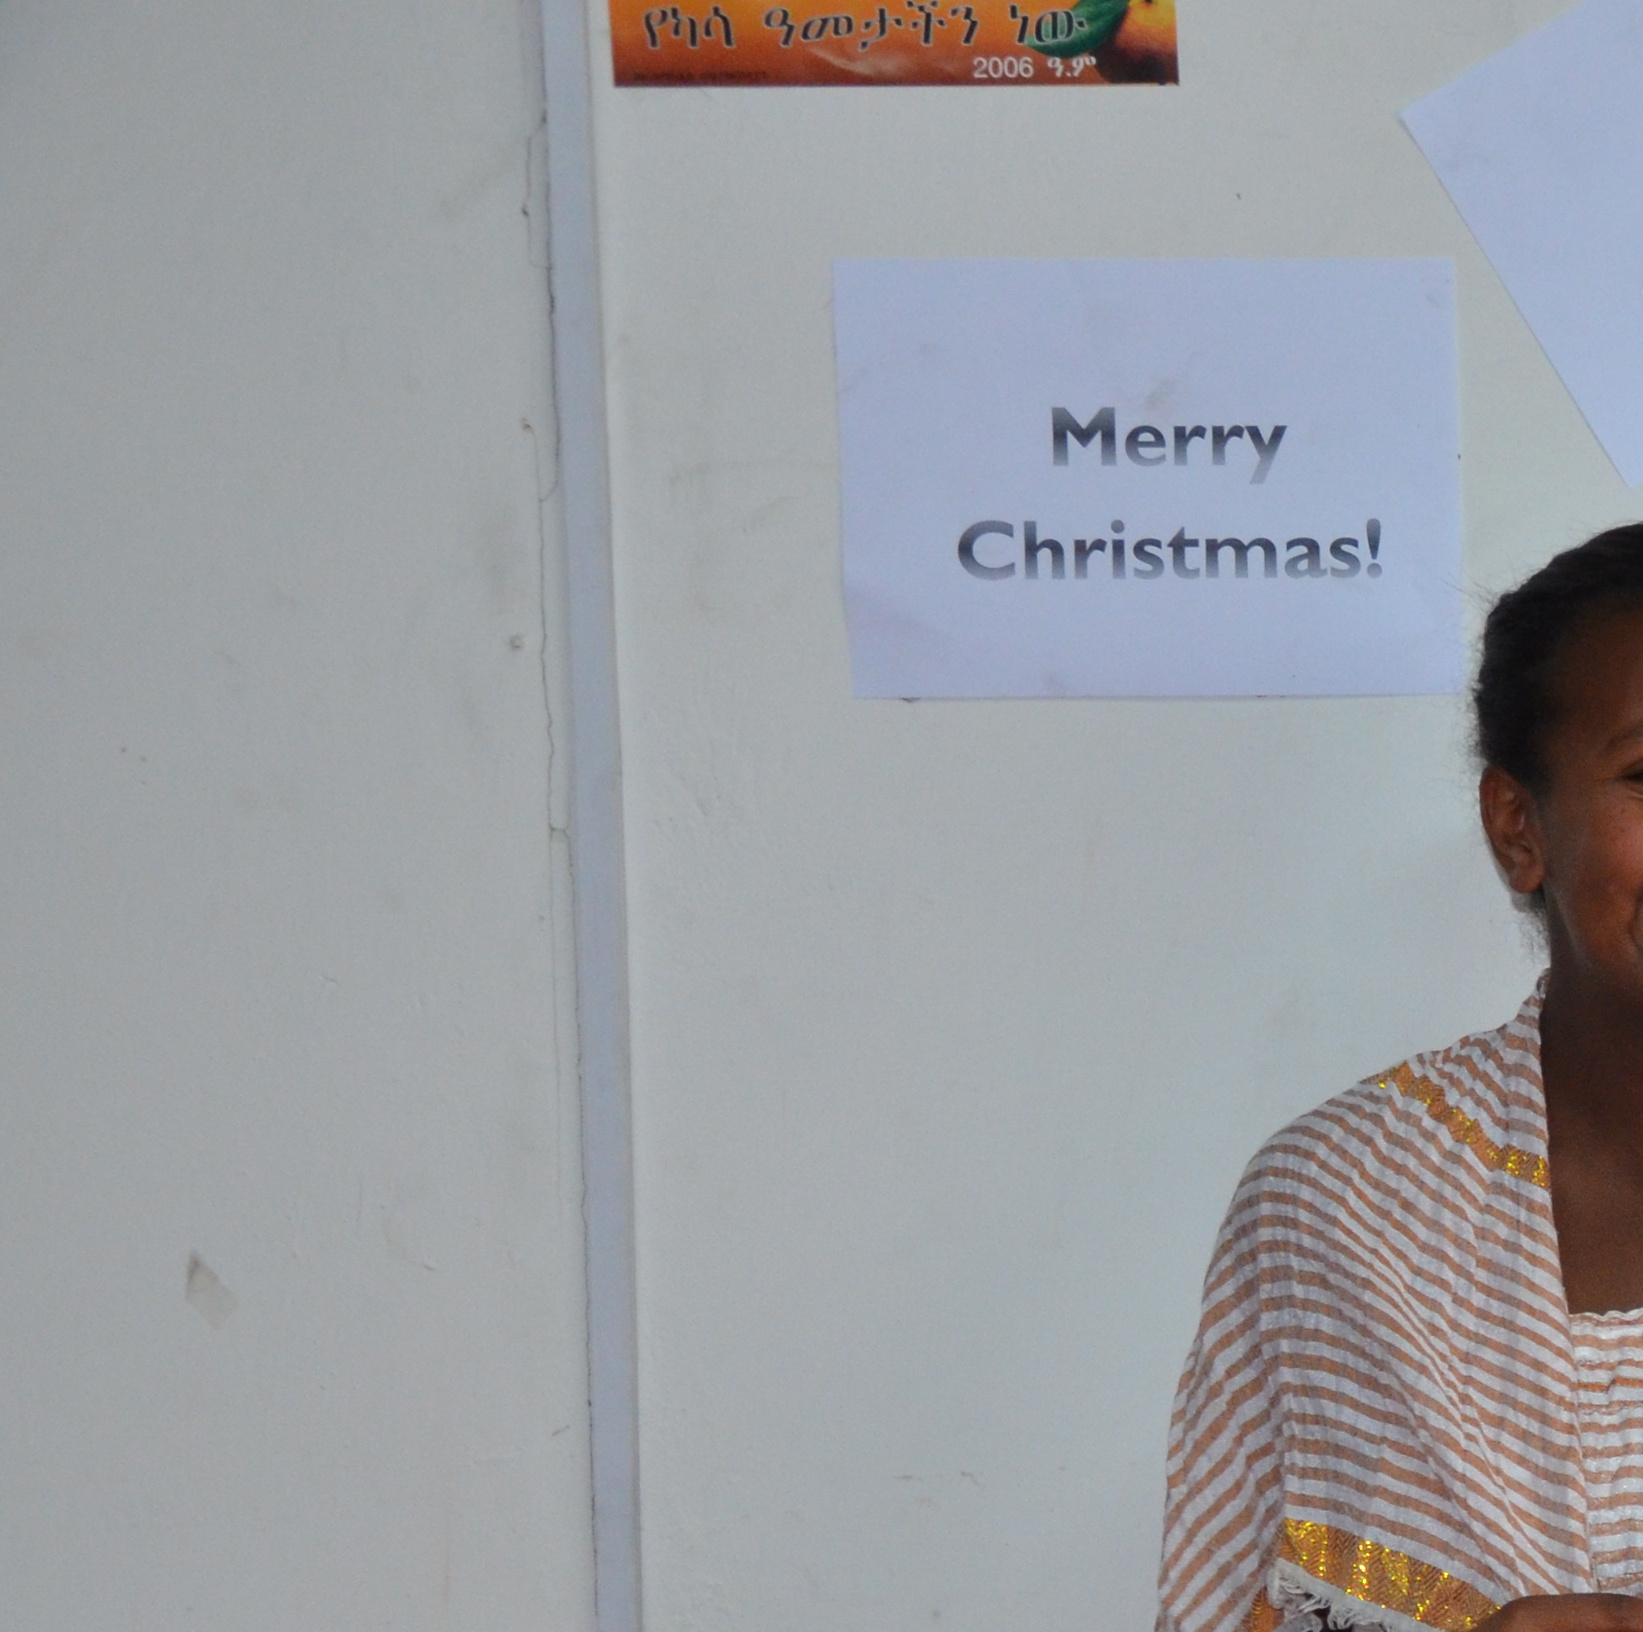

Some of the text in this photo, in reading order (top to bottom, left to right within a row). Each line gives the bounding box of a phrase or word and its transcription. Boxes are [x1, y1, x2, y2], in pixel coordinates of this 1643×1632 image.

[972, 56, 1034, 78] 2006
[1051, 406, 1288, 485] Merry
[957, 518, 1384, 582] Christmas!
